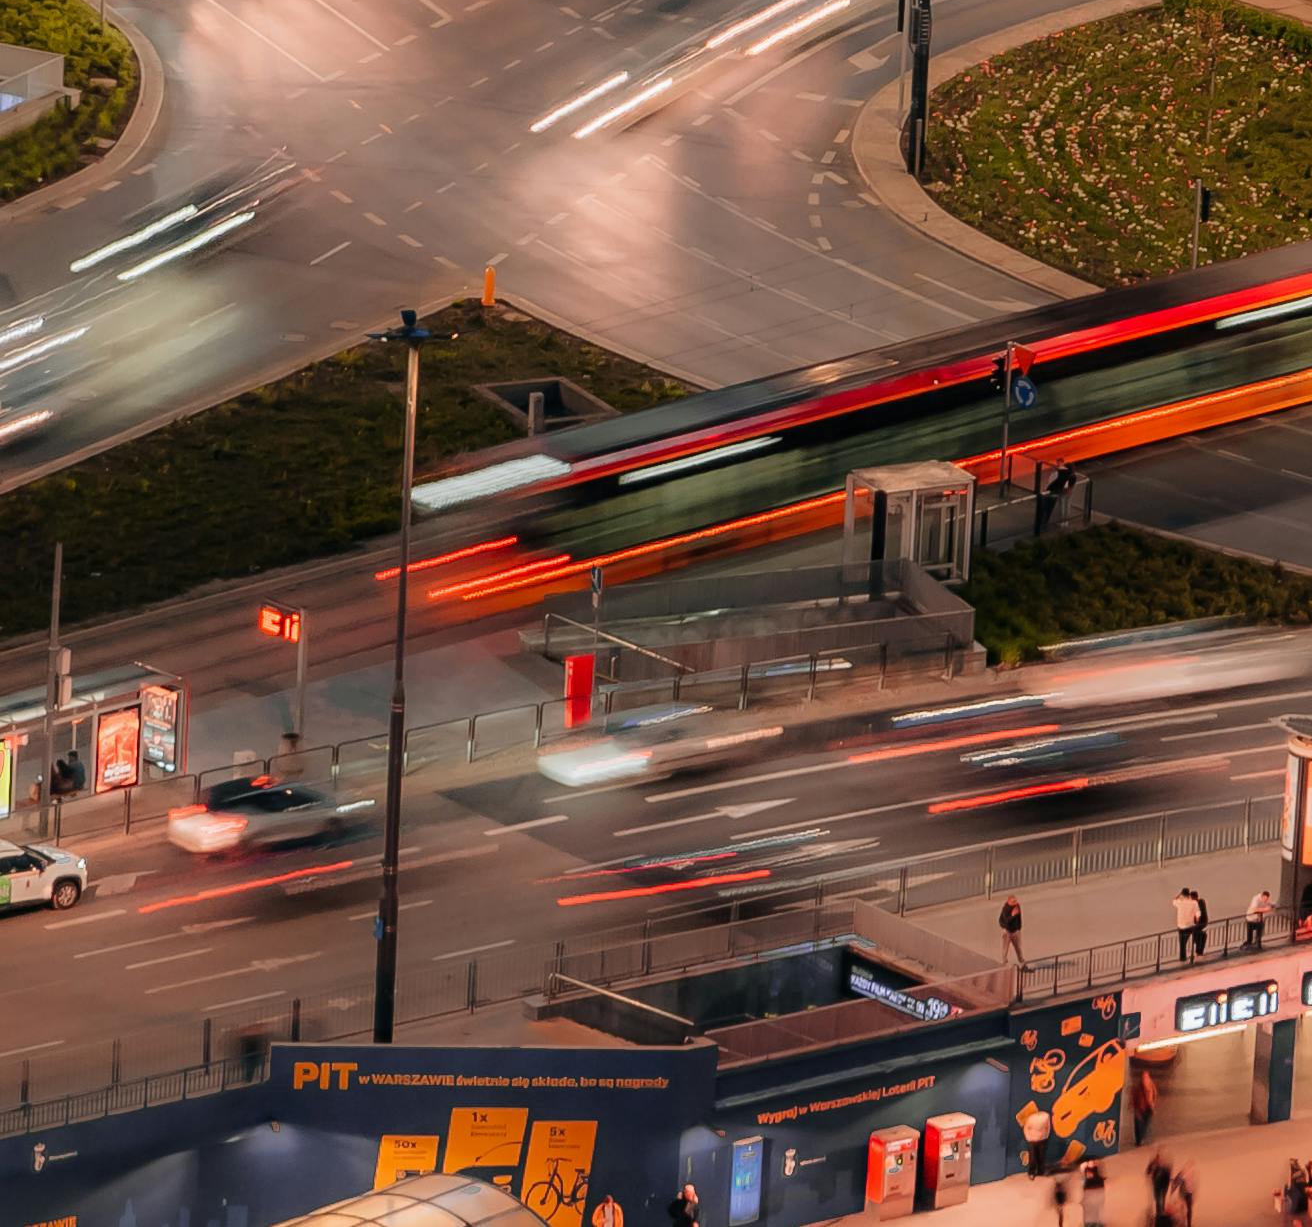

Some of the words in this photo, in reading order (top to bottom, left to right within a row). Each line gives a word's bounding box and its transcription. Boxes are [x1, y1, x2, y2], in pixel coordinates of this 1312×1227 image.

[293, 1062, 358, 1090] PIT
[359, 1075, 370, 1085] w
[372, 1074, 455, 1086] WARSZAWIE
[580, 1076, 597, 1087] bo
[615, 1077, 669, 1089] nagrody
[757, 1105, 798, 1124] Wygraj
[799, 1106, 809, 1115] w
[809, 1087, 882, 1113] Warszawskiej
[882, 1080, 917, 1098] Loterii
[917, 1075, 936, 1090] PIT
